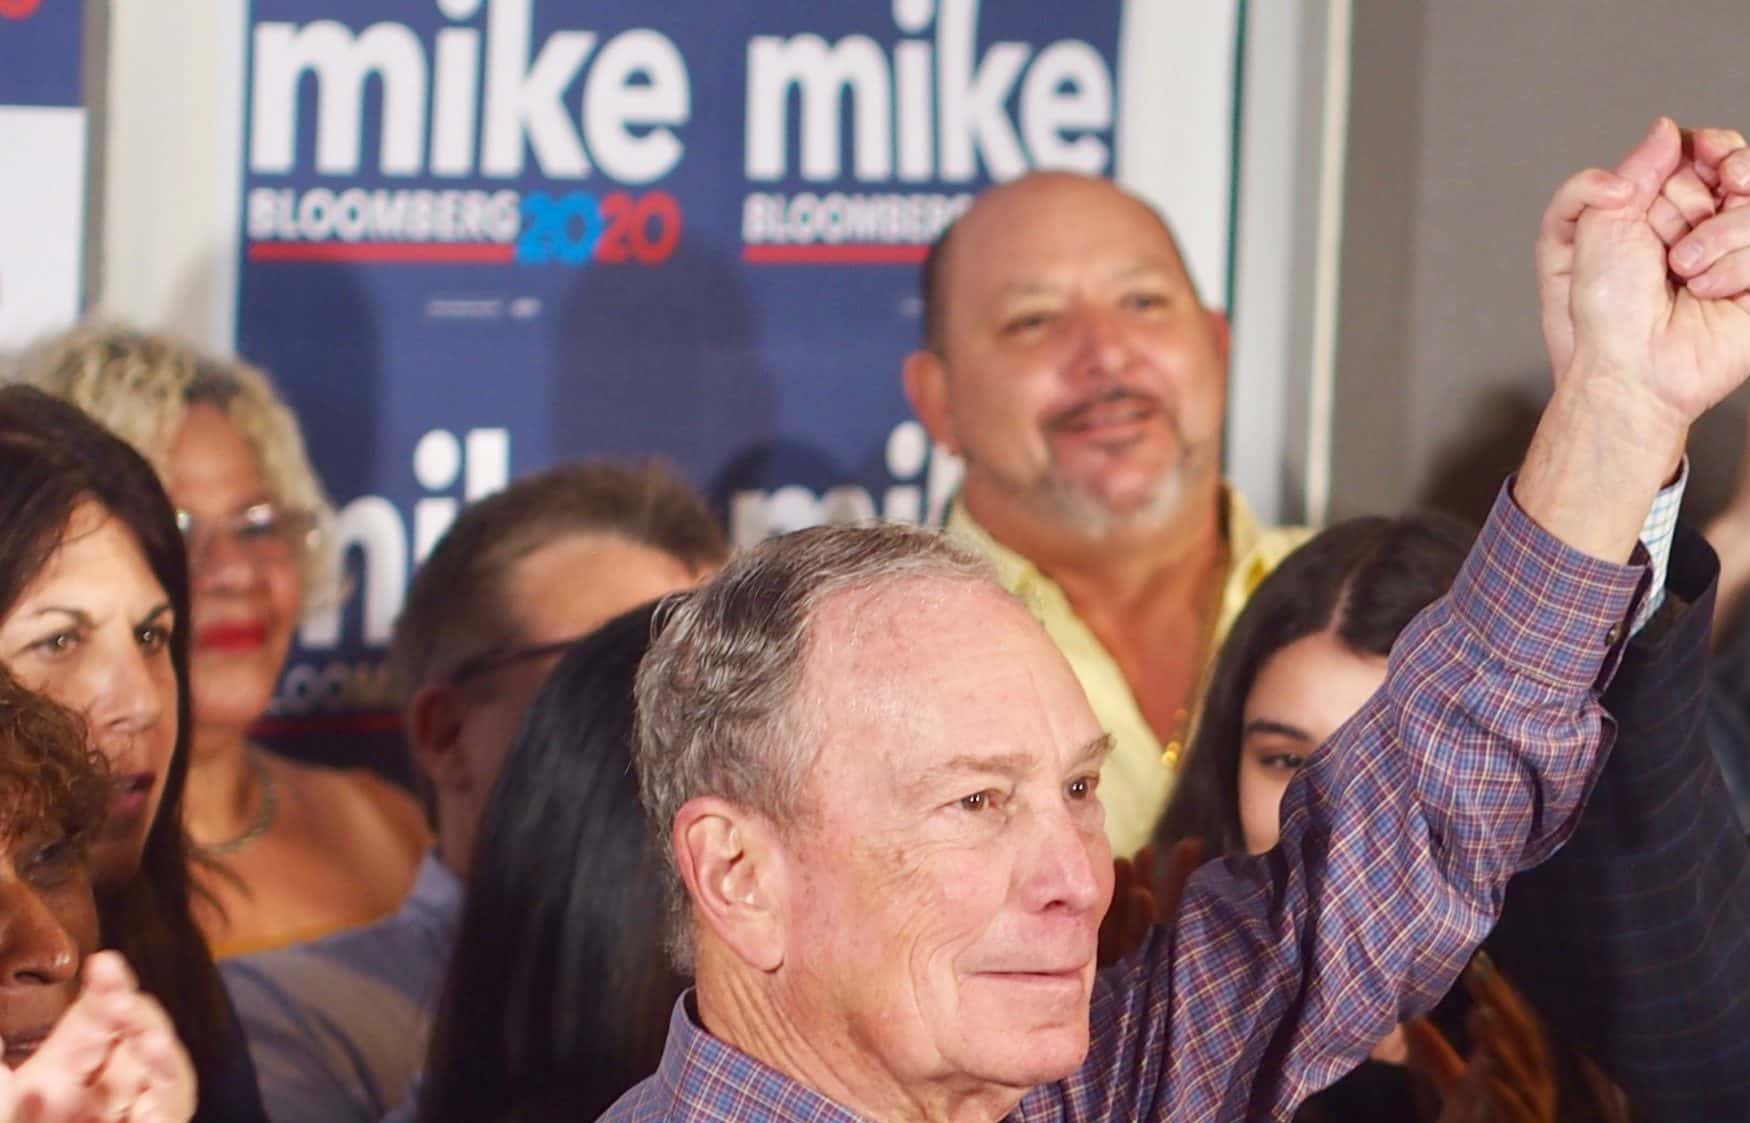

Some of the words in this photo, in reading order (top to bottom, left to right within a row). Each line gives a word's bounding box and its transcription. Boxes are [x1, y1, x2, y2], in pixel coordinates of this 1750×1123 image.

[250, 0, 691, 184] mike
[745, 0, 1114, 184] mike
[247, 187, 521, 241] BLOOMBERG
[515, 189, 684, 266] 2020
